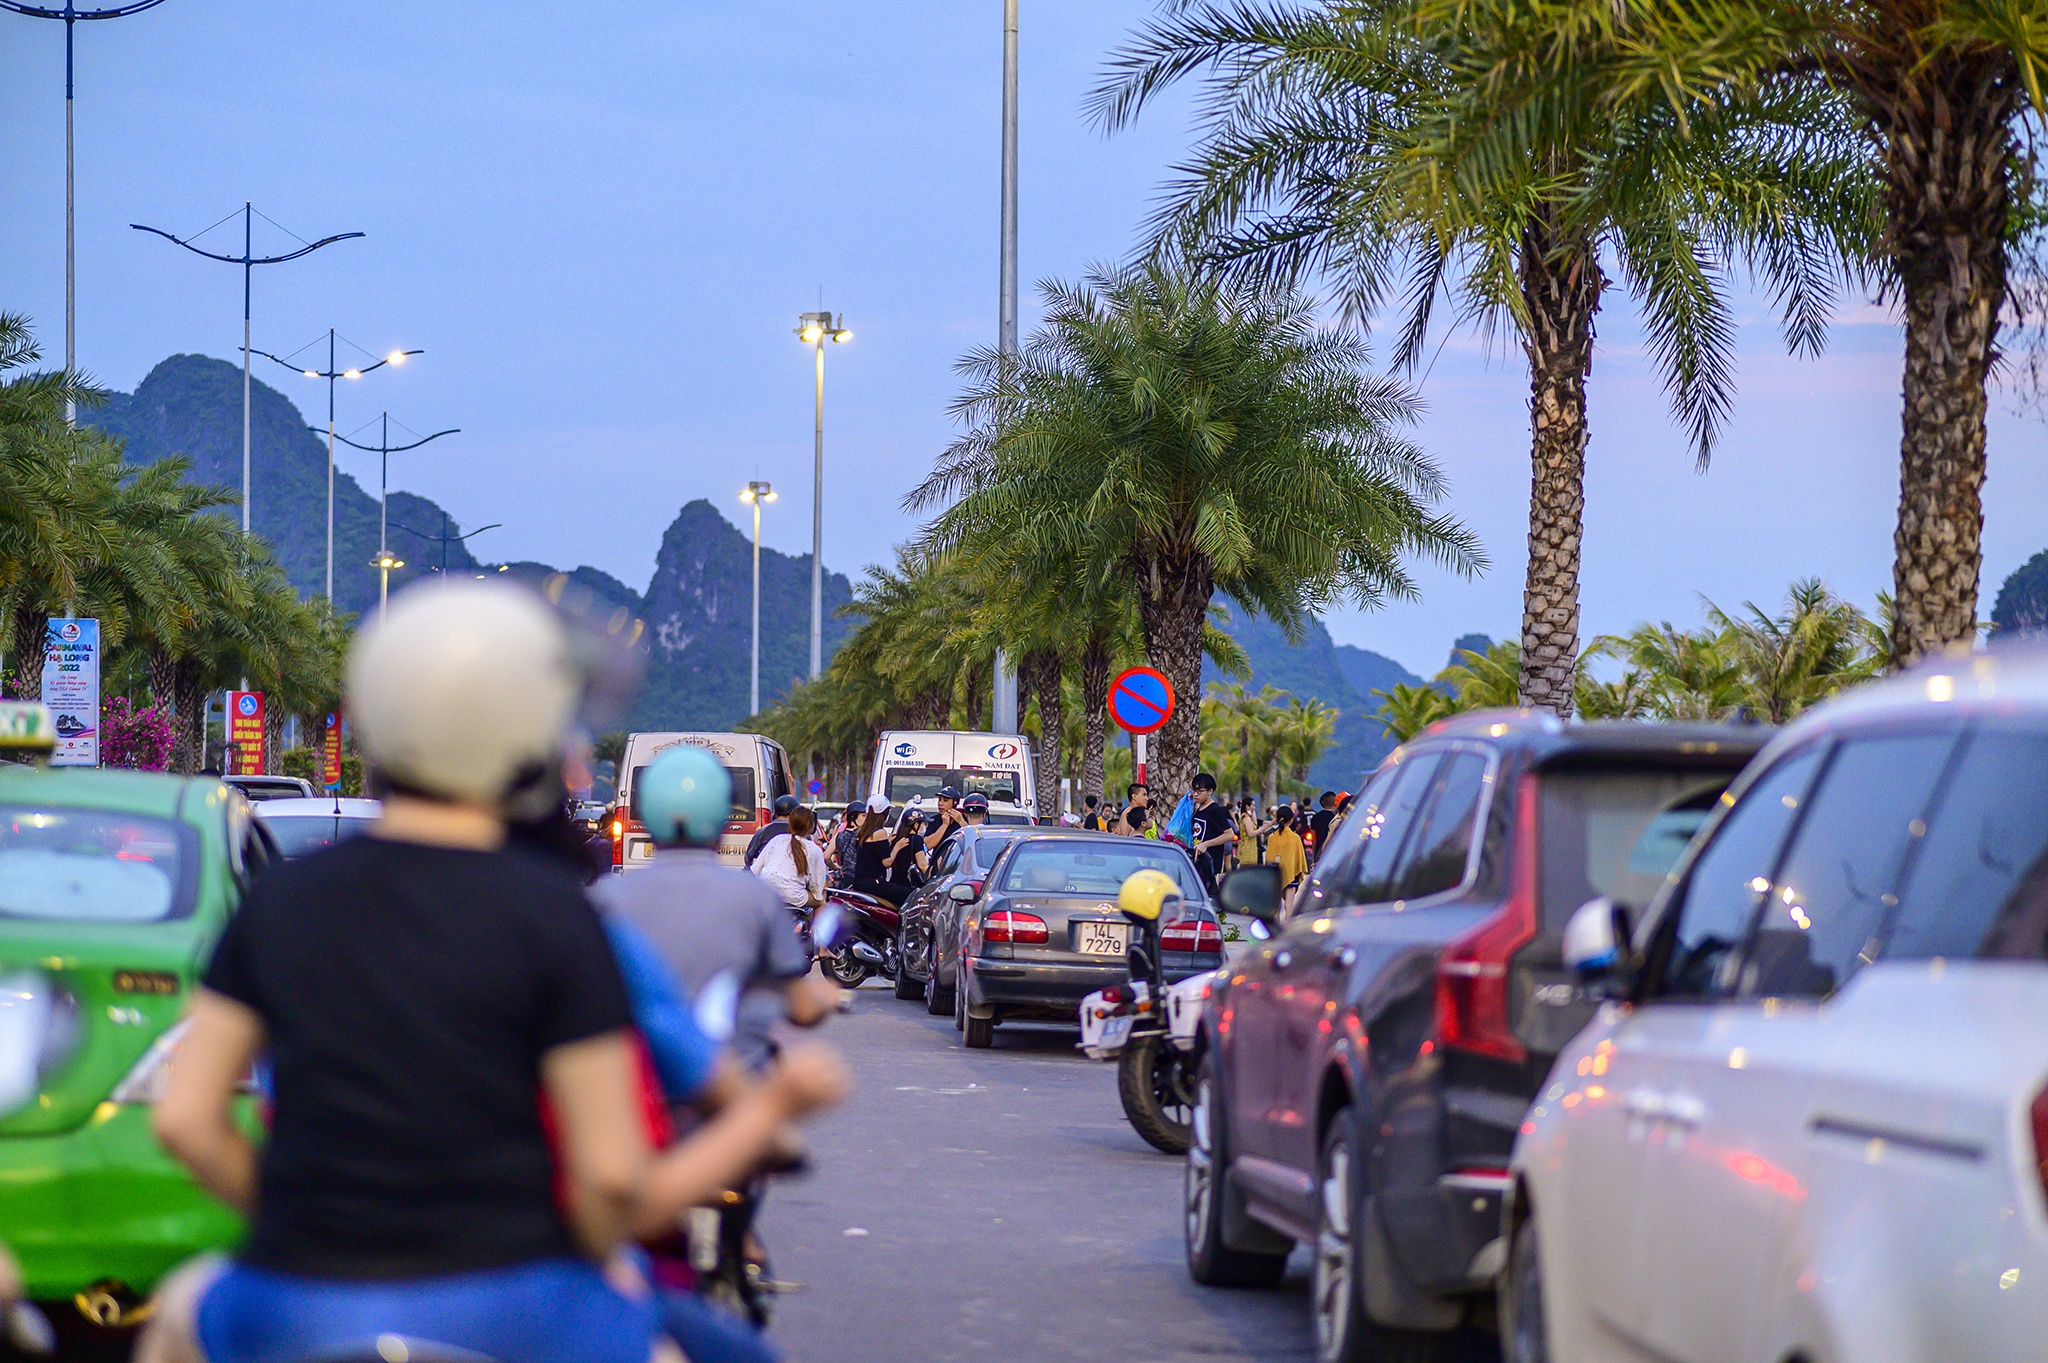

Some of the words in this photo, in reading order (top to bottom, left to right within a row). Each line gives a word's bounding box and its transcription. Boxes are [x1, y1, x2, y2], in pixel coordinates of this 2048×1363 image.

[46, 644, 93, 652] CARNAVAL
[49, 654, 62, 663] HẠ
[65, 654, 90, 662] LONG
[1093, 924, 1115, 939] 14L
[1086, 938, 1121, 953] 7279
